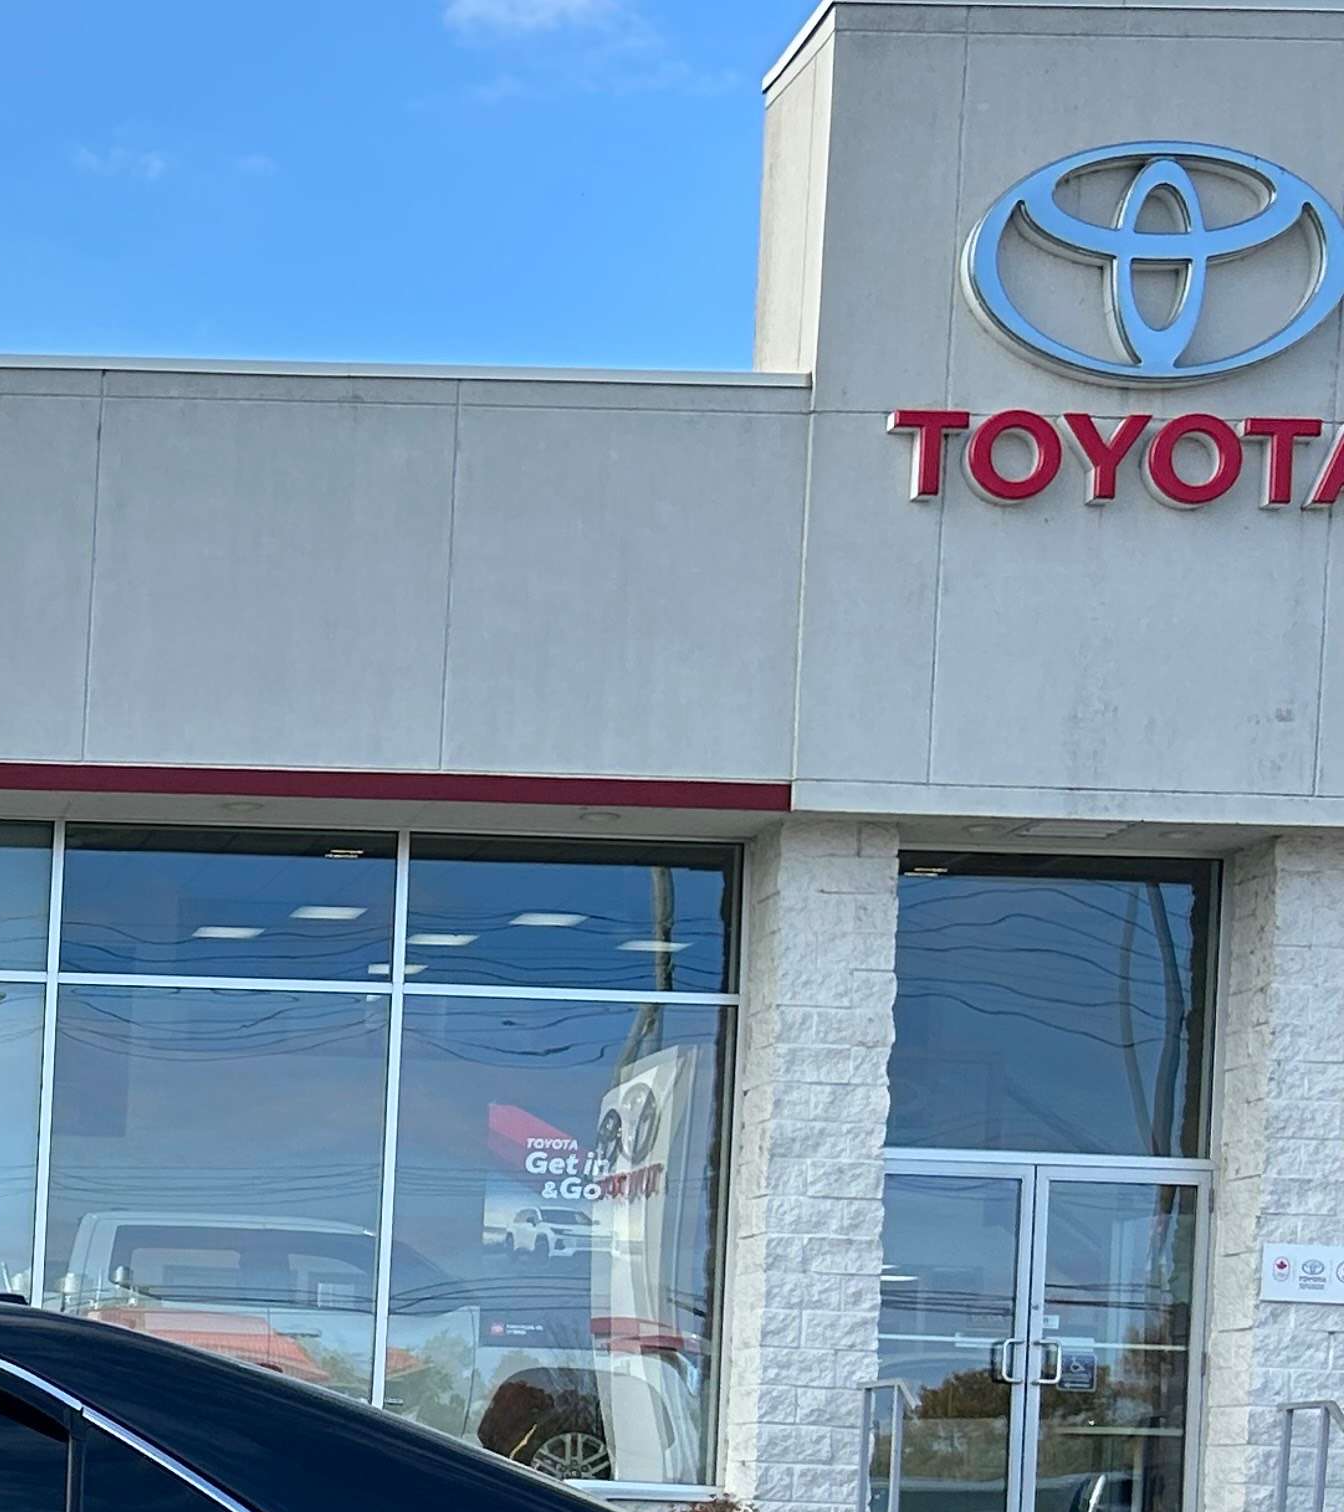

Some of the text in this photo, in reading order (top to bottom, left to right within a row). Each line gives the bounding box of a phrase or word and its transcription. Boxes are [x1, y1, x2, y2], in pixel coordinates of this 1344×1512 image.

[526, 1137, 579, 1151] TOYOTA
[525, 1151, 610, 1176] Get in
[542, 1176, 602, 1200] &Go
